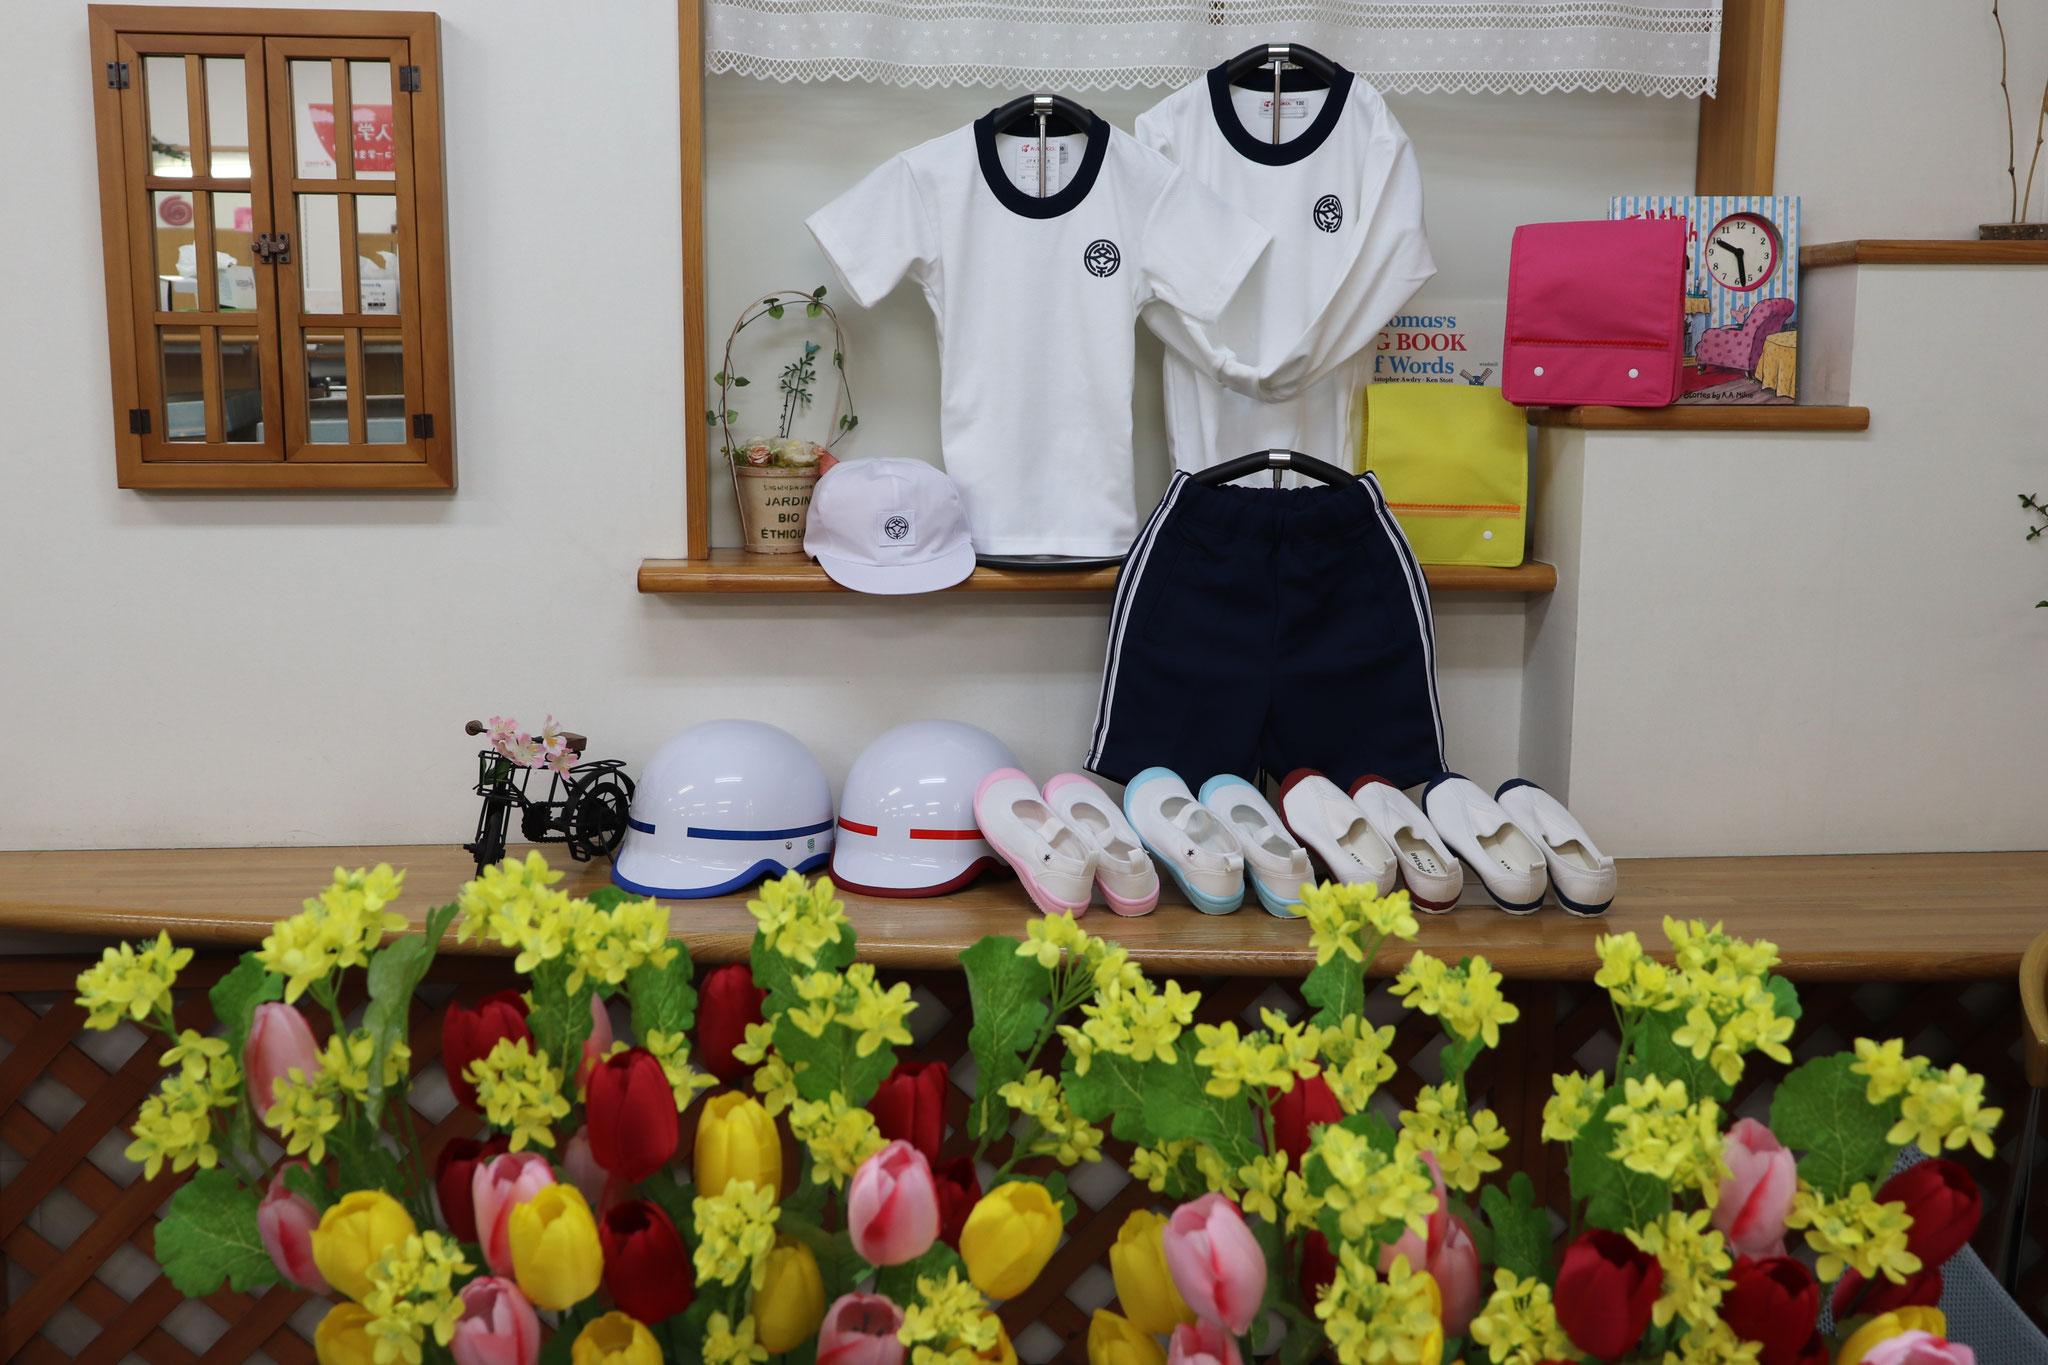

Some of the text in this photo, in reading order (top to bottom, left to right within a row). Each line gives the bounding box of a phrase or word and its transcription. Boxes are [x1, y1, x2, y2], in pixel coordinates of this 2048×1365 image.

[1721, 226, 1730, 234] 11
[1736, 221, 1746, 230] 12
[1751, 226, 1756, 235] 1
[1760, 237, 1766, 245] 2
[1708, 248, 1714, 256] 9
[1763, 252, 1770, 260] 3
[1712, 262, 1719, 271] 8
[1757, 265, 1763, 273] 4
[1721, 272, 1728, 280] 7
[1747, 274, 1753, 282] 5
[1734, 278, 1740, 286] 6
[1385, 315, 1456, 329] omas's
[1395, 332, 1467, 351] BOOK
[1388, 355, 1455, 375] Words
[1684, 390, 1711, 399] Stories
[1711, 392, 1721, 400] by
[1736, 391, 1754, 399] Milne
[764, 496, 811, 507] JARDIN
[778, 512, 800, 523] BIO
[761, 526, 806, 539] ÉTHIQU
